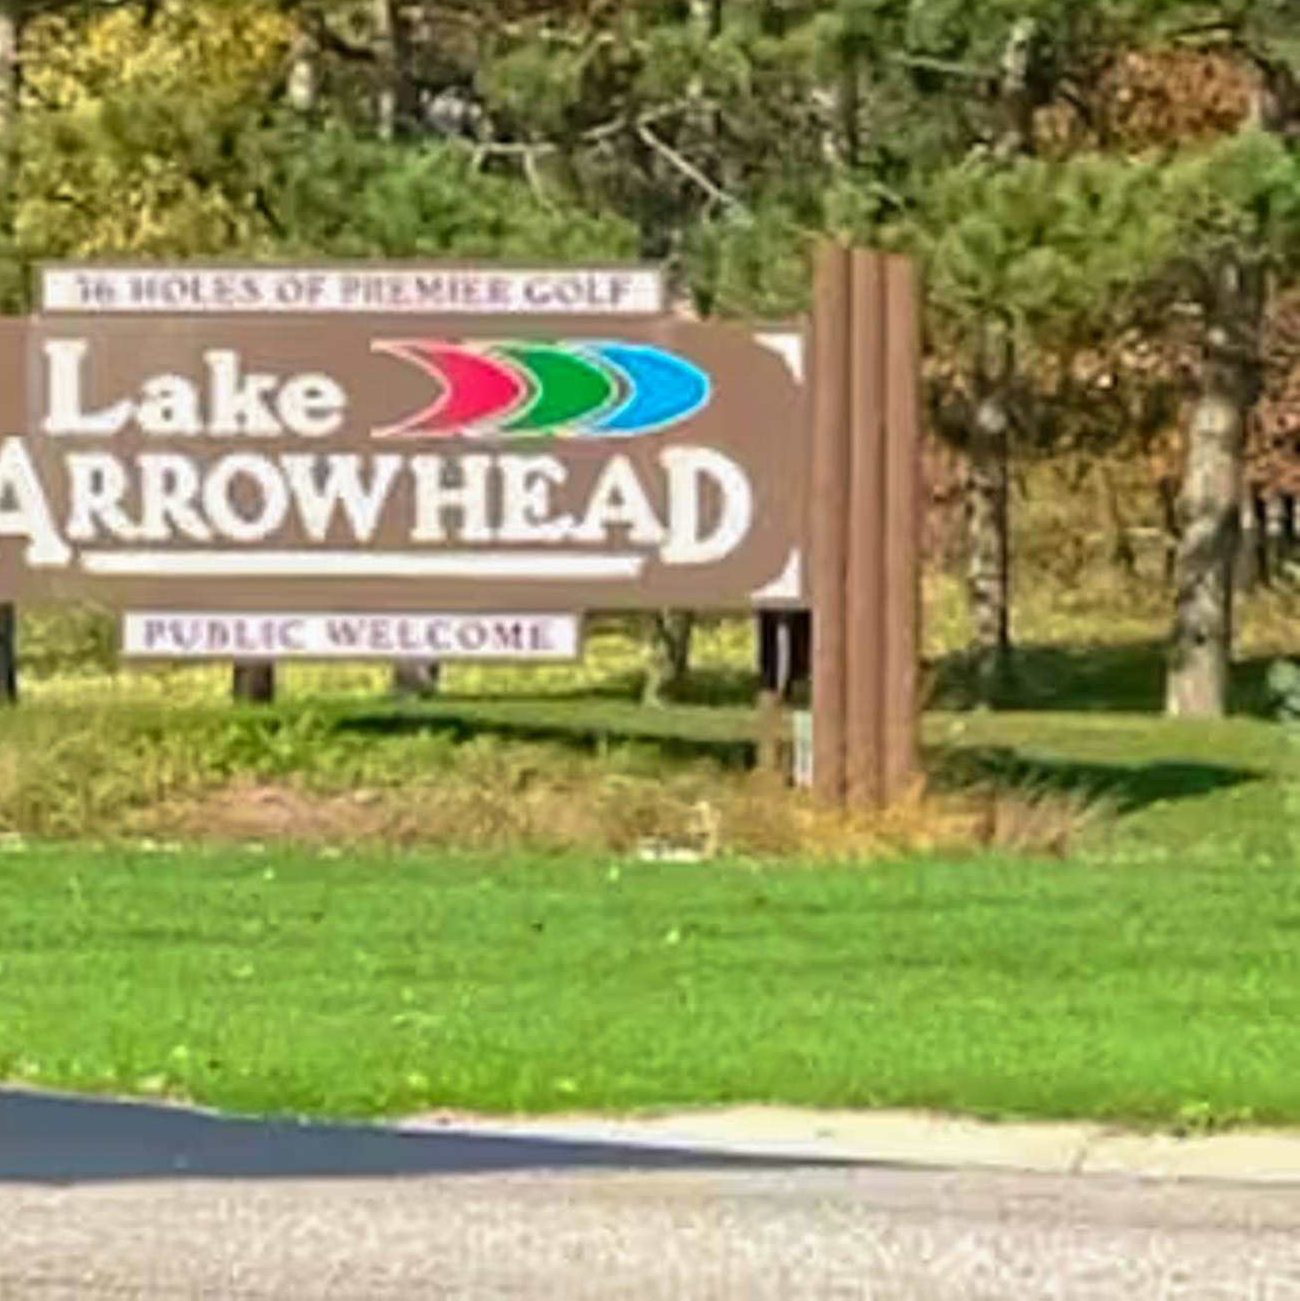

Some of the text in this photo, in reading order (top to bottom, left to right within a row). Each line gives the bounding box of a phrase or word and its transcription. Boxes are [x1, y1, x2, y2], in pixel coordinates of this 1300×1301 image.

[128, 275, 263, 303] HOLES
[274, 275, 326, 303] OF
[339, 275, 513, 304] PREMIER
[522, 276, 632, 304] GOLF
[42, 338, 347, 437] Lake
[143, 619, 555, 650] PUBLIC WELCOME
